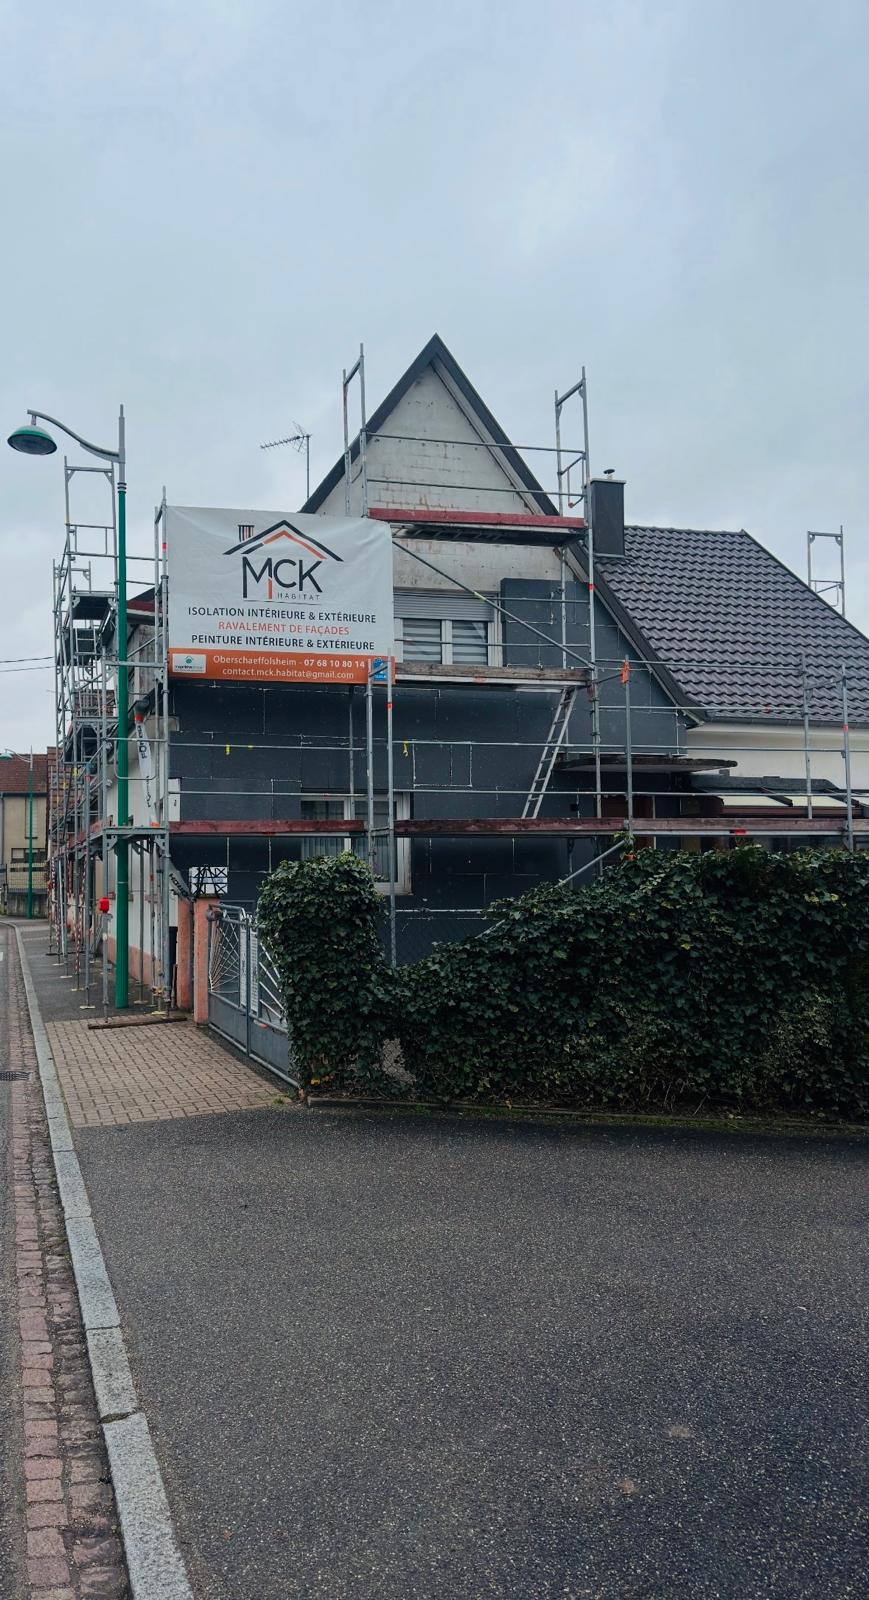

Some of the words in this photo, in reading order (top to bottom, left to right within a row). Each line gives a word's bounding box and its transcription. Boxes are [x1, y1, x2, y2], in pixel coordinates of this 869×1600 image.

[242, 556, 323, 599] MCK
[277, 592, 321, 601] HABITAT
[188, 606, 244, 617] ISOLATION
[247, 607, 306, 620] INTÉRIEURE
[308, 611, 316, 621] &
[318, 611, 376, 624] EXTÉRIEURE
[218, 621, 287, 633] RAVALEMENT
[289, 624, 302, 633] DE
[305, 625, 350, 636] FAÇADES
[191, 634, 243, 645] PEINTURE
[245, 635, 304, 648] INTÉRIEURE
[306, 639, 314, 648] &
[316, 639, 375, 651] EXTÉRIEURE
[213, 655, 297, 667] Oberschaeffolsheim
[304, 659, 315, 667] 07
[316, 659, 328, 668] 68
[330, 660, 340, 668] 10
[342, 660, 353, 669] 80
[355, 661, 365, 669] 14
[222, 667, 354, 679] contact.mck.habitat@gmail.com
